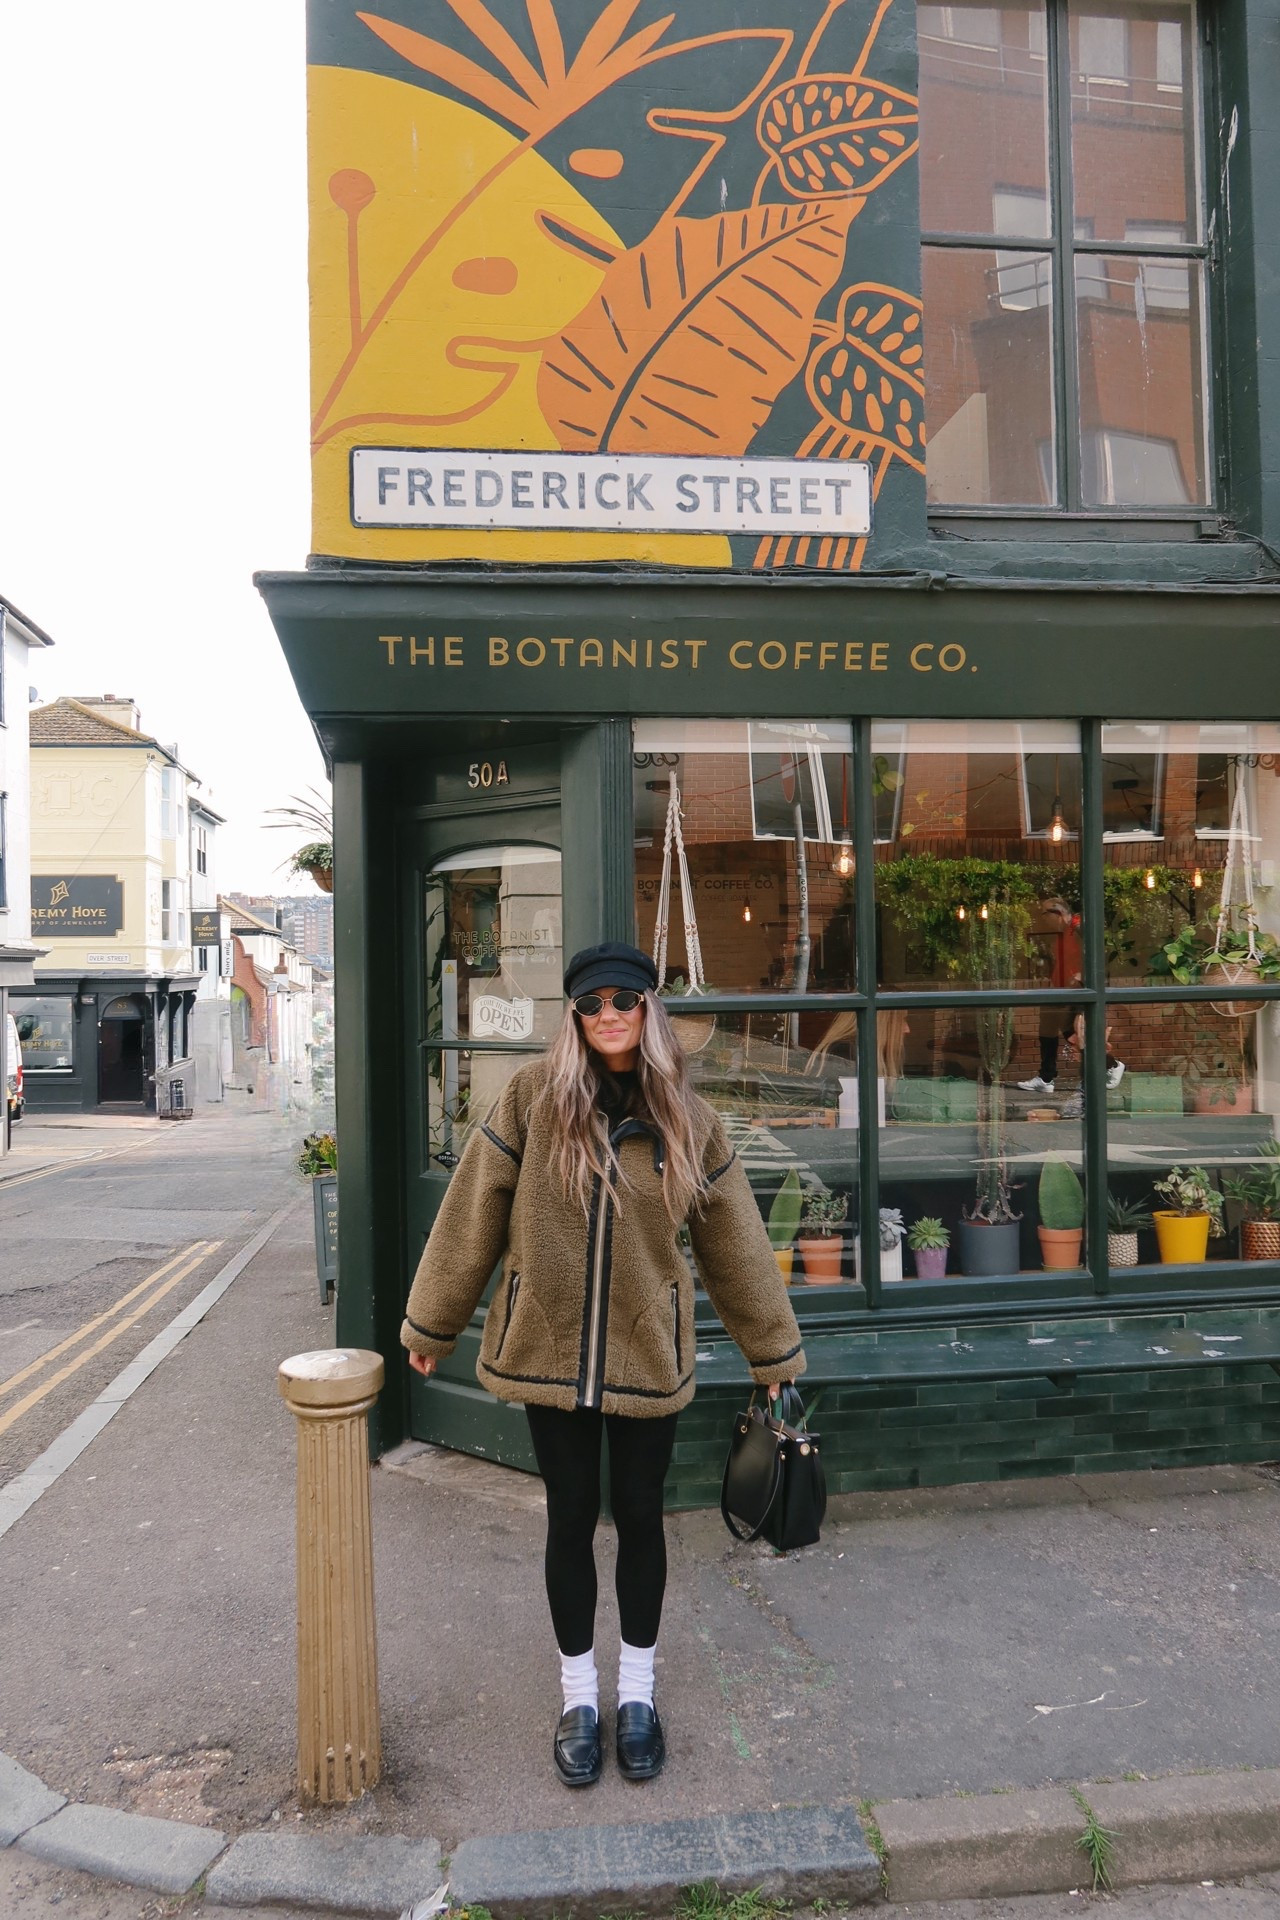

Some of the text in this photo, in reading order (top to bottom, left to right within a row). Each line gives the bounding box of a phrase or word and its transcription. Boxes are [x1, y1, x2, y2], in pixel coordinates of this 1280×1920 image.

[377, 466, 852, 517] FREDERICK STREET
[378, 635, 979, 673] THE BOTANIST COFFEE CO.
[637, 879, 774, 890] BOTNT COFFEE CO.
[31, 906, 107, 919] REMY HOYE
[453, 929, 549, 945] THE BOTANIST
[461, 945, 540, 959] COFFEE CO.
[480, 1006, 525, 1033] OPEN
